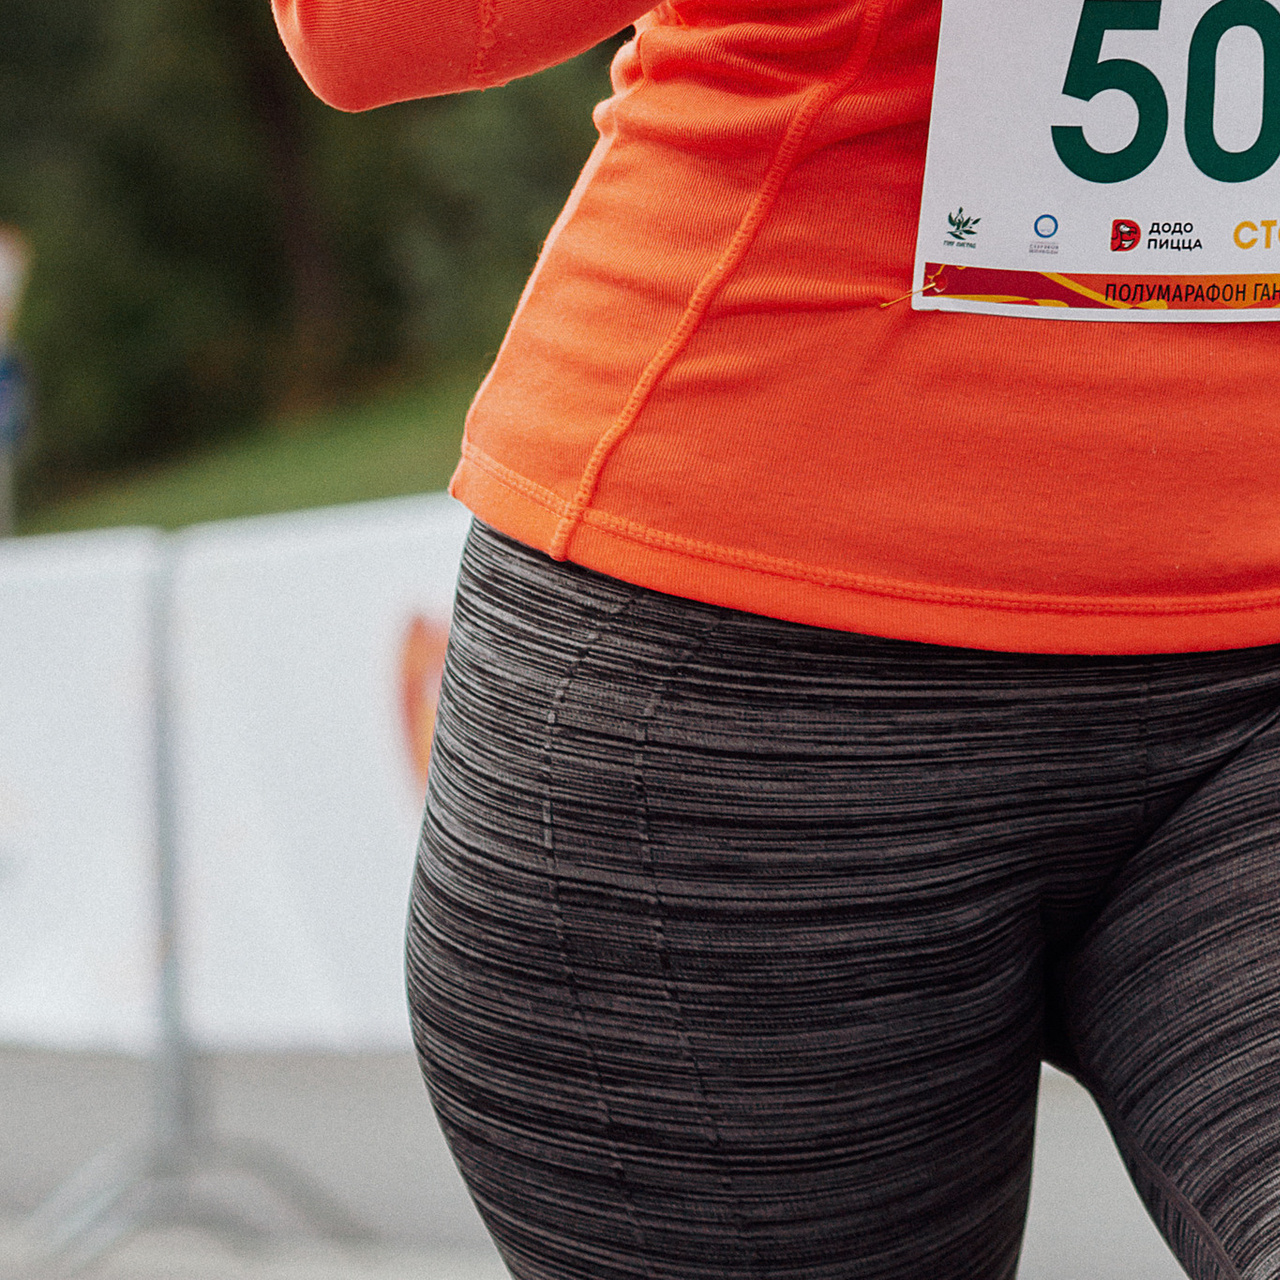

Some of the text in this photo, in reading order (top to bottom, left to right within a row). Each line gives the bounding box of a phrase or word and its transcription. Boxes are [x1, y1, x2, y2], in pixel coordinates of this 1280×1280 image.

[1149, 222, 1194, 236] ДОДО
[1147, 238, 1203, 251] ПИЦЦА
[1105, 283, 1247, 302] ПОЛУМАРАФОН
